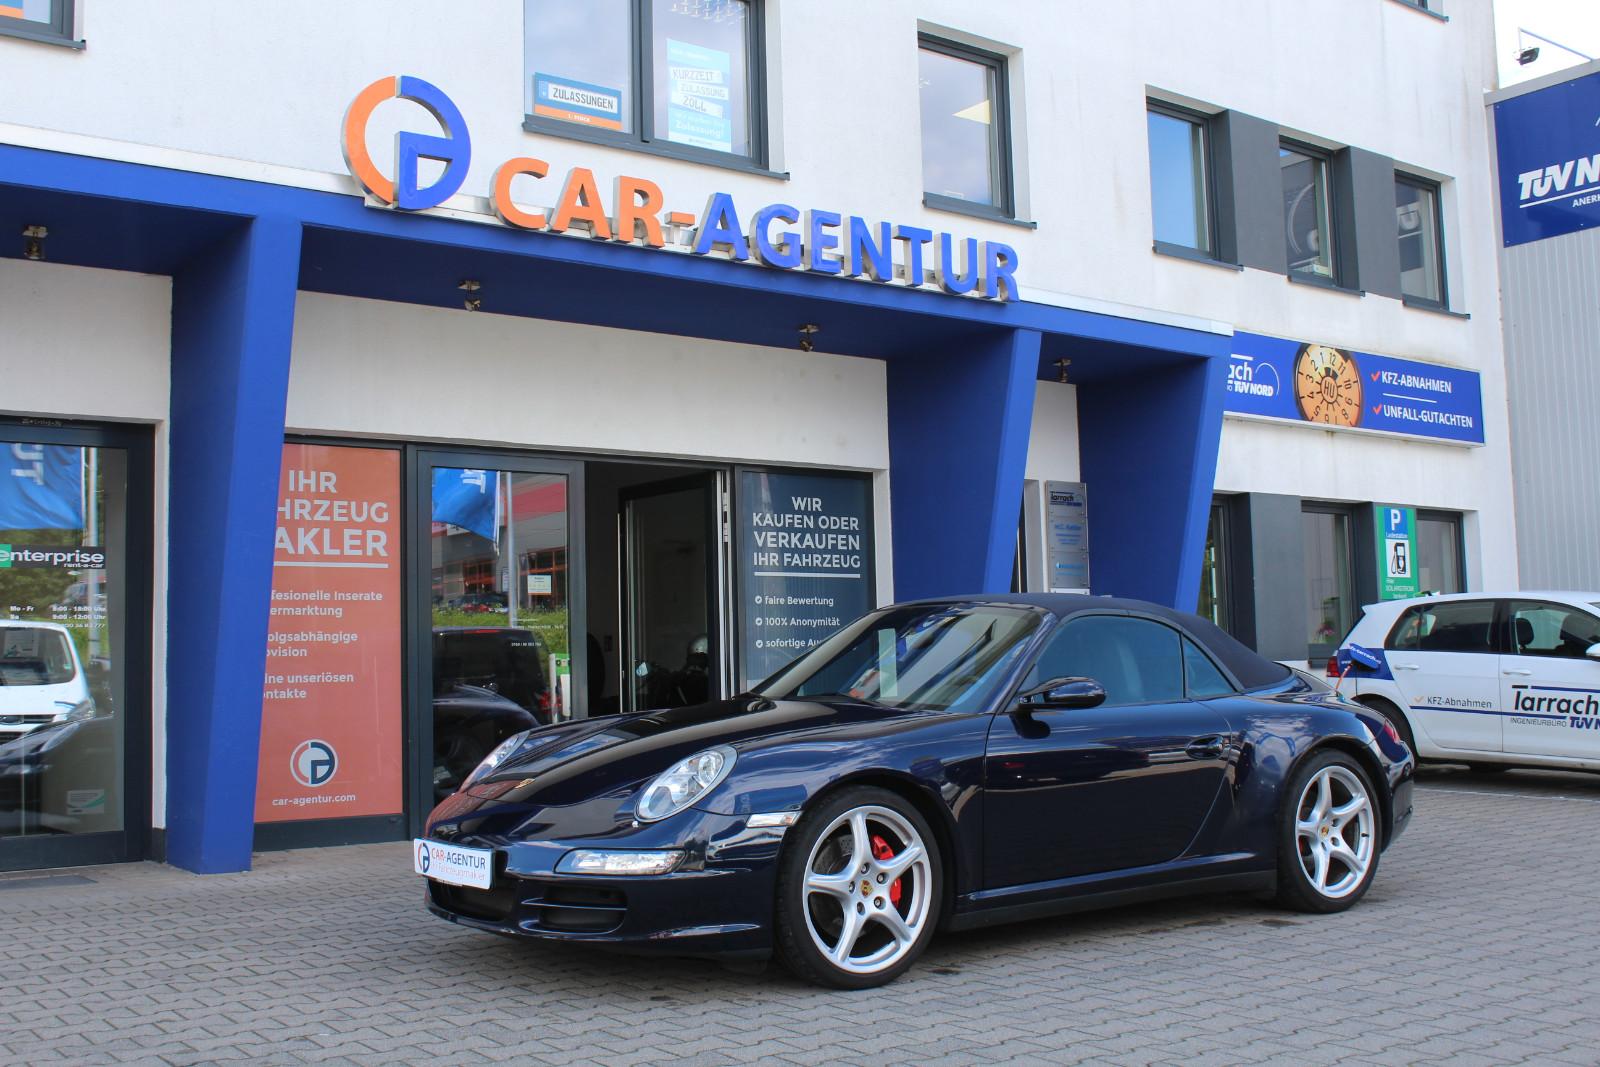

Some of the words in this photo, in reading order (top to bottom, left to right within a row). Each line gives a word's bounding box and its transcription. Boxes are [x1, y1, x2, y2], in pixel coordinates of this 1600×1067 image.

[552, 87, 614, 110] ZULASSUNGEN
[1518, 160, 1575, 201] TÜV
[491, 157, 1019, 300] CAR-AGENTUR
[1329, 352, 1337, 366] 12
[1250, 383, 1274, 397] NORD
[1323, 379, 1336, 399] HU
[1381, 370, 1452, 394] KFZ-ABNAHMEN
[1383, 404, 1473, 429] UNFALL-GUTACHTEN
[288, 470, 337, 493] IHR
[791, 496, 822, 512] WIR
[752, 512, 814, 529] KAUFEN
[818, 515, 859, 531] ODER
[1390, 508, 1401, 531] P
[275, 527, 389, 557] AKLER
[753, 531, 860, 550] VERKAUFEN
[753, 552, 779, 566] IHR
[783, 553, 861, 568] FAHRZEUG
[334, 591, 383, 601] Inserate
[764, 595, 785, 605] faire
[787, 596, 834, 607] Bewertung
[270, 605, 343, 618] ermarktung
[765, 617, 788, 626] 100%
[790, 617, 840, 628] Anonymität
[765, 637, 806, 649] sofortige
[287, 672, 354, 683] unseriösen
[1427, 696, 1492, 709] KFZ-Abnahmen
[1511, 684, 1599, 715] Tarrach
[1569, 716, 1594, 729] TÜV
[272, 793, 356, 806] car-agentur.com
[431, 847, 486, 870] CAR-AGENTUR
